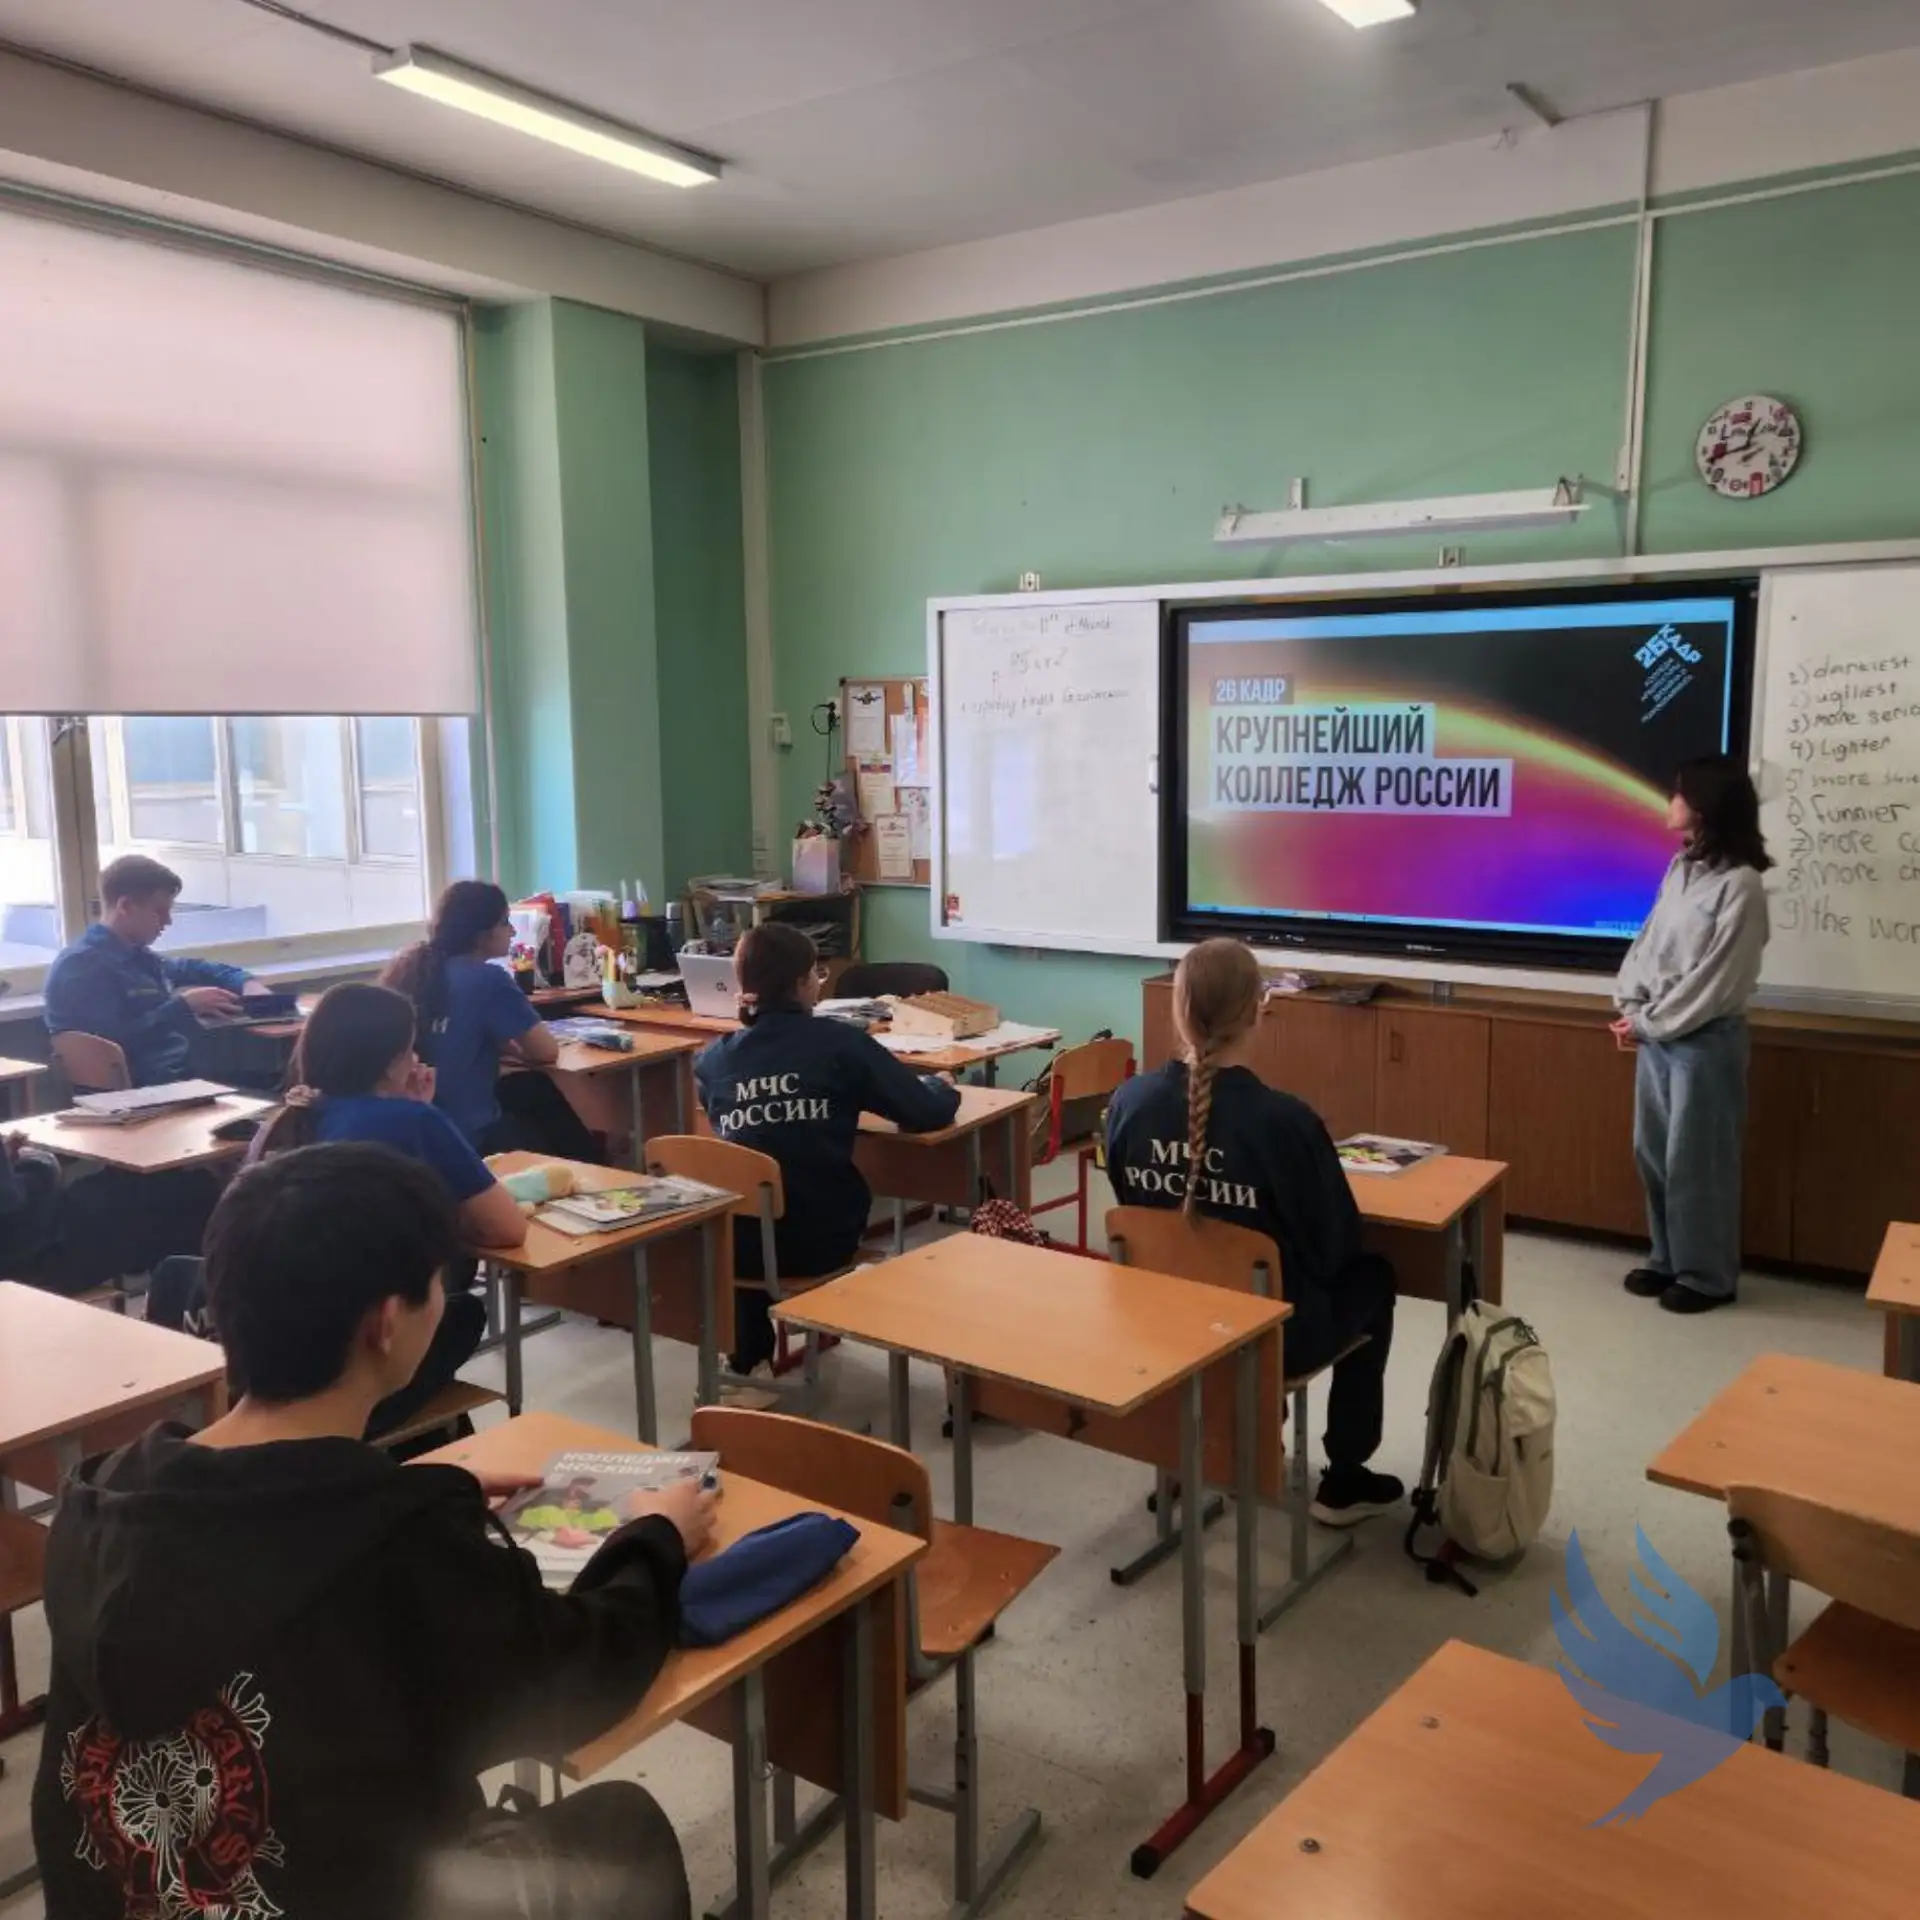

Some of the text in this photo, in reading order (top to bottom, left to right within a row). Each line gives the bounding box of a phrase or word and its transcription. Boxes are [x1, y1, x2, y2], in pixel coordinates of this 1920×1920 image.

[1216, 678, 1286, 704] 26 КАДР
[1216, 705, 1424, 754] КРУПНЕЙШИЙ
[1789, 739, 1814, 763] 4)
[1216, 766, 1500, 809] КОЛЛЕДЖ РОССИИ
[735, 1072, 800, 1102] МЧС
[720, 1098, 830, 1136] РОССИИ
